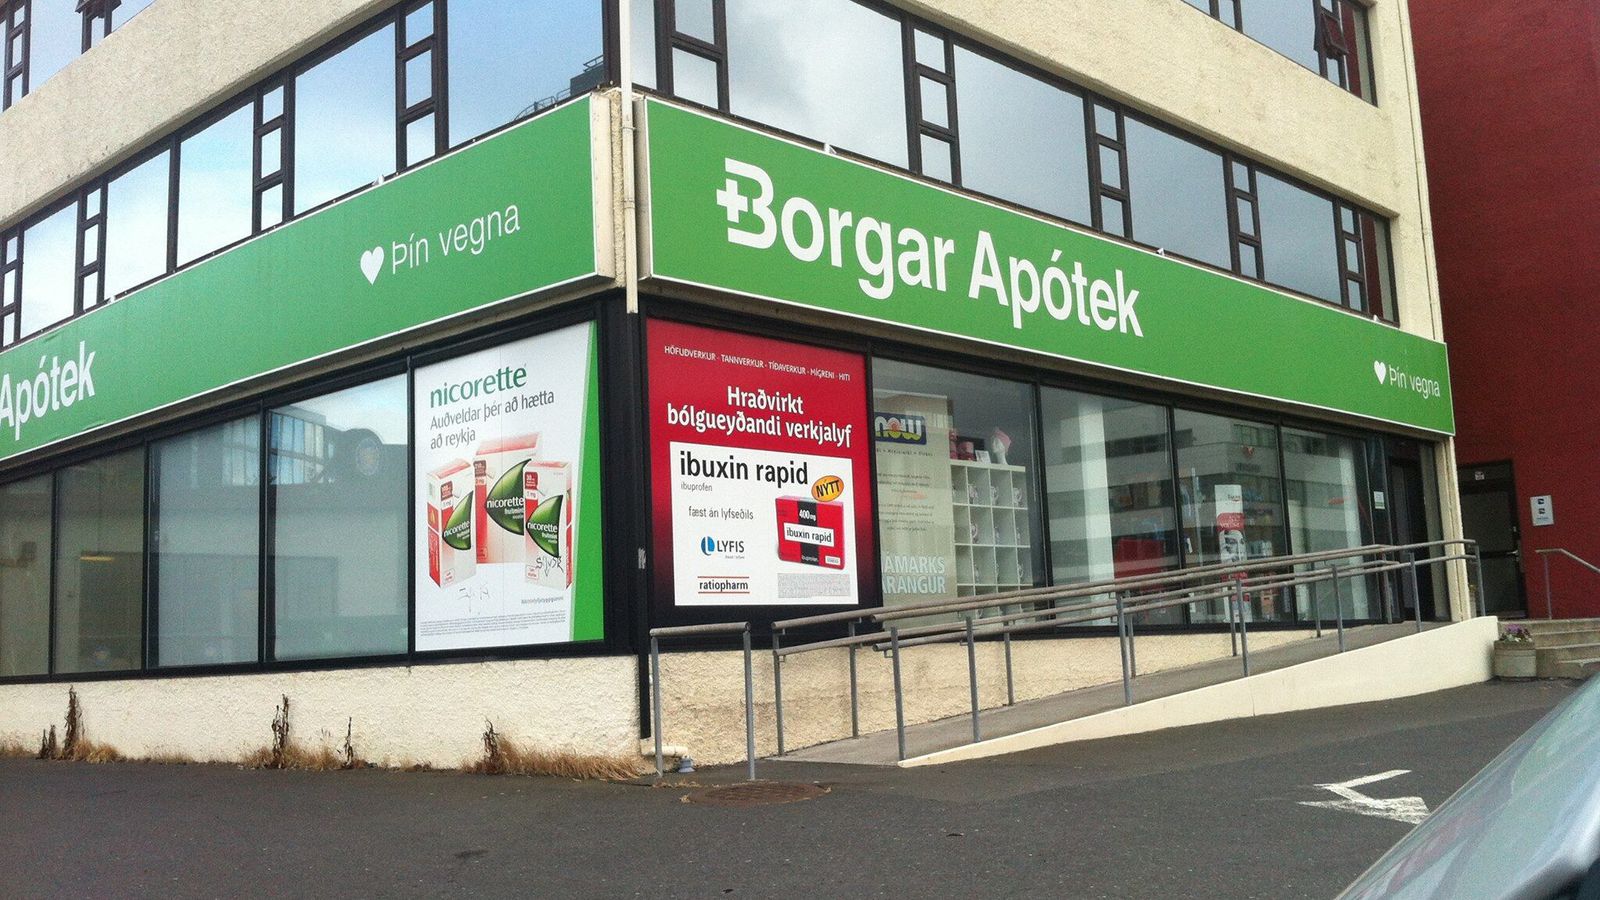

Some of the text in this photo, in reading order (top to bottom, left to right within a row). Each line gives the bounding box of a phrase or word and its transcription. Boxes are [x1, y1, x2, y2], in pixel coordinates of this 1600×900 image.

[392, 204, 521, 275] Þín vegna
[716, 157, 1144, 338] Borgar Apótek
[721, 354, 764, 368] TANNVERKUR
[0, 340, 96, 441] Apótek
[430, 366, 527, 409] nicorette
[1410, 375, 1440, 399] vegna
[430, 390, 555, 430] Auðveldar þér að hætta
[727, 385, 804, 414] Hraðvirkt
[667, 403, 852, 448] bólgueyðandi verkjalyf
[430, 426, 476, 450] að reykja
[680, 450, 808, 488] ibuxin rapid
[681, 481, 712, 492] ibuprofen
[816, 480, 840, 498] NÝTT
[486, 496, 524, 508] nicorette
[688, 505, 754, 521] fæst án lyfseðils
[443, 520, 471, 537] nicorette
[527, 522, 558, 533] nicorette
[786, 526, 832, 543] ibuxin rapid
[717, 540, 745, 553] LYFIS
[881, 551, 945, 573] ÁMARKS
[699, 579, 749, 592] ratiopharm
